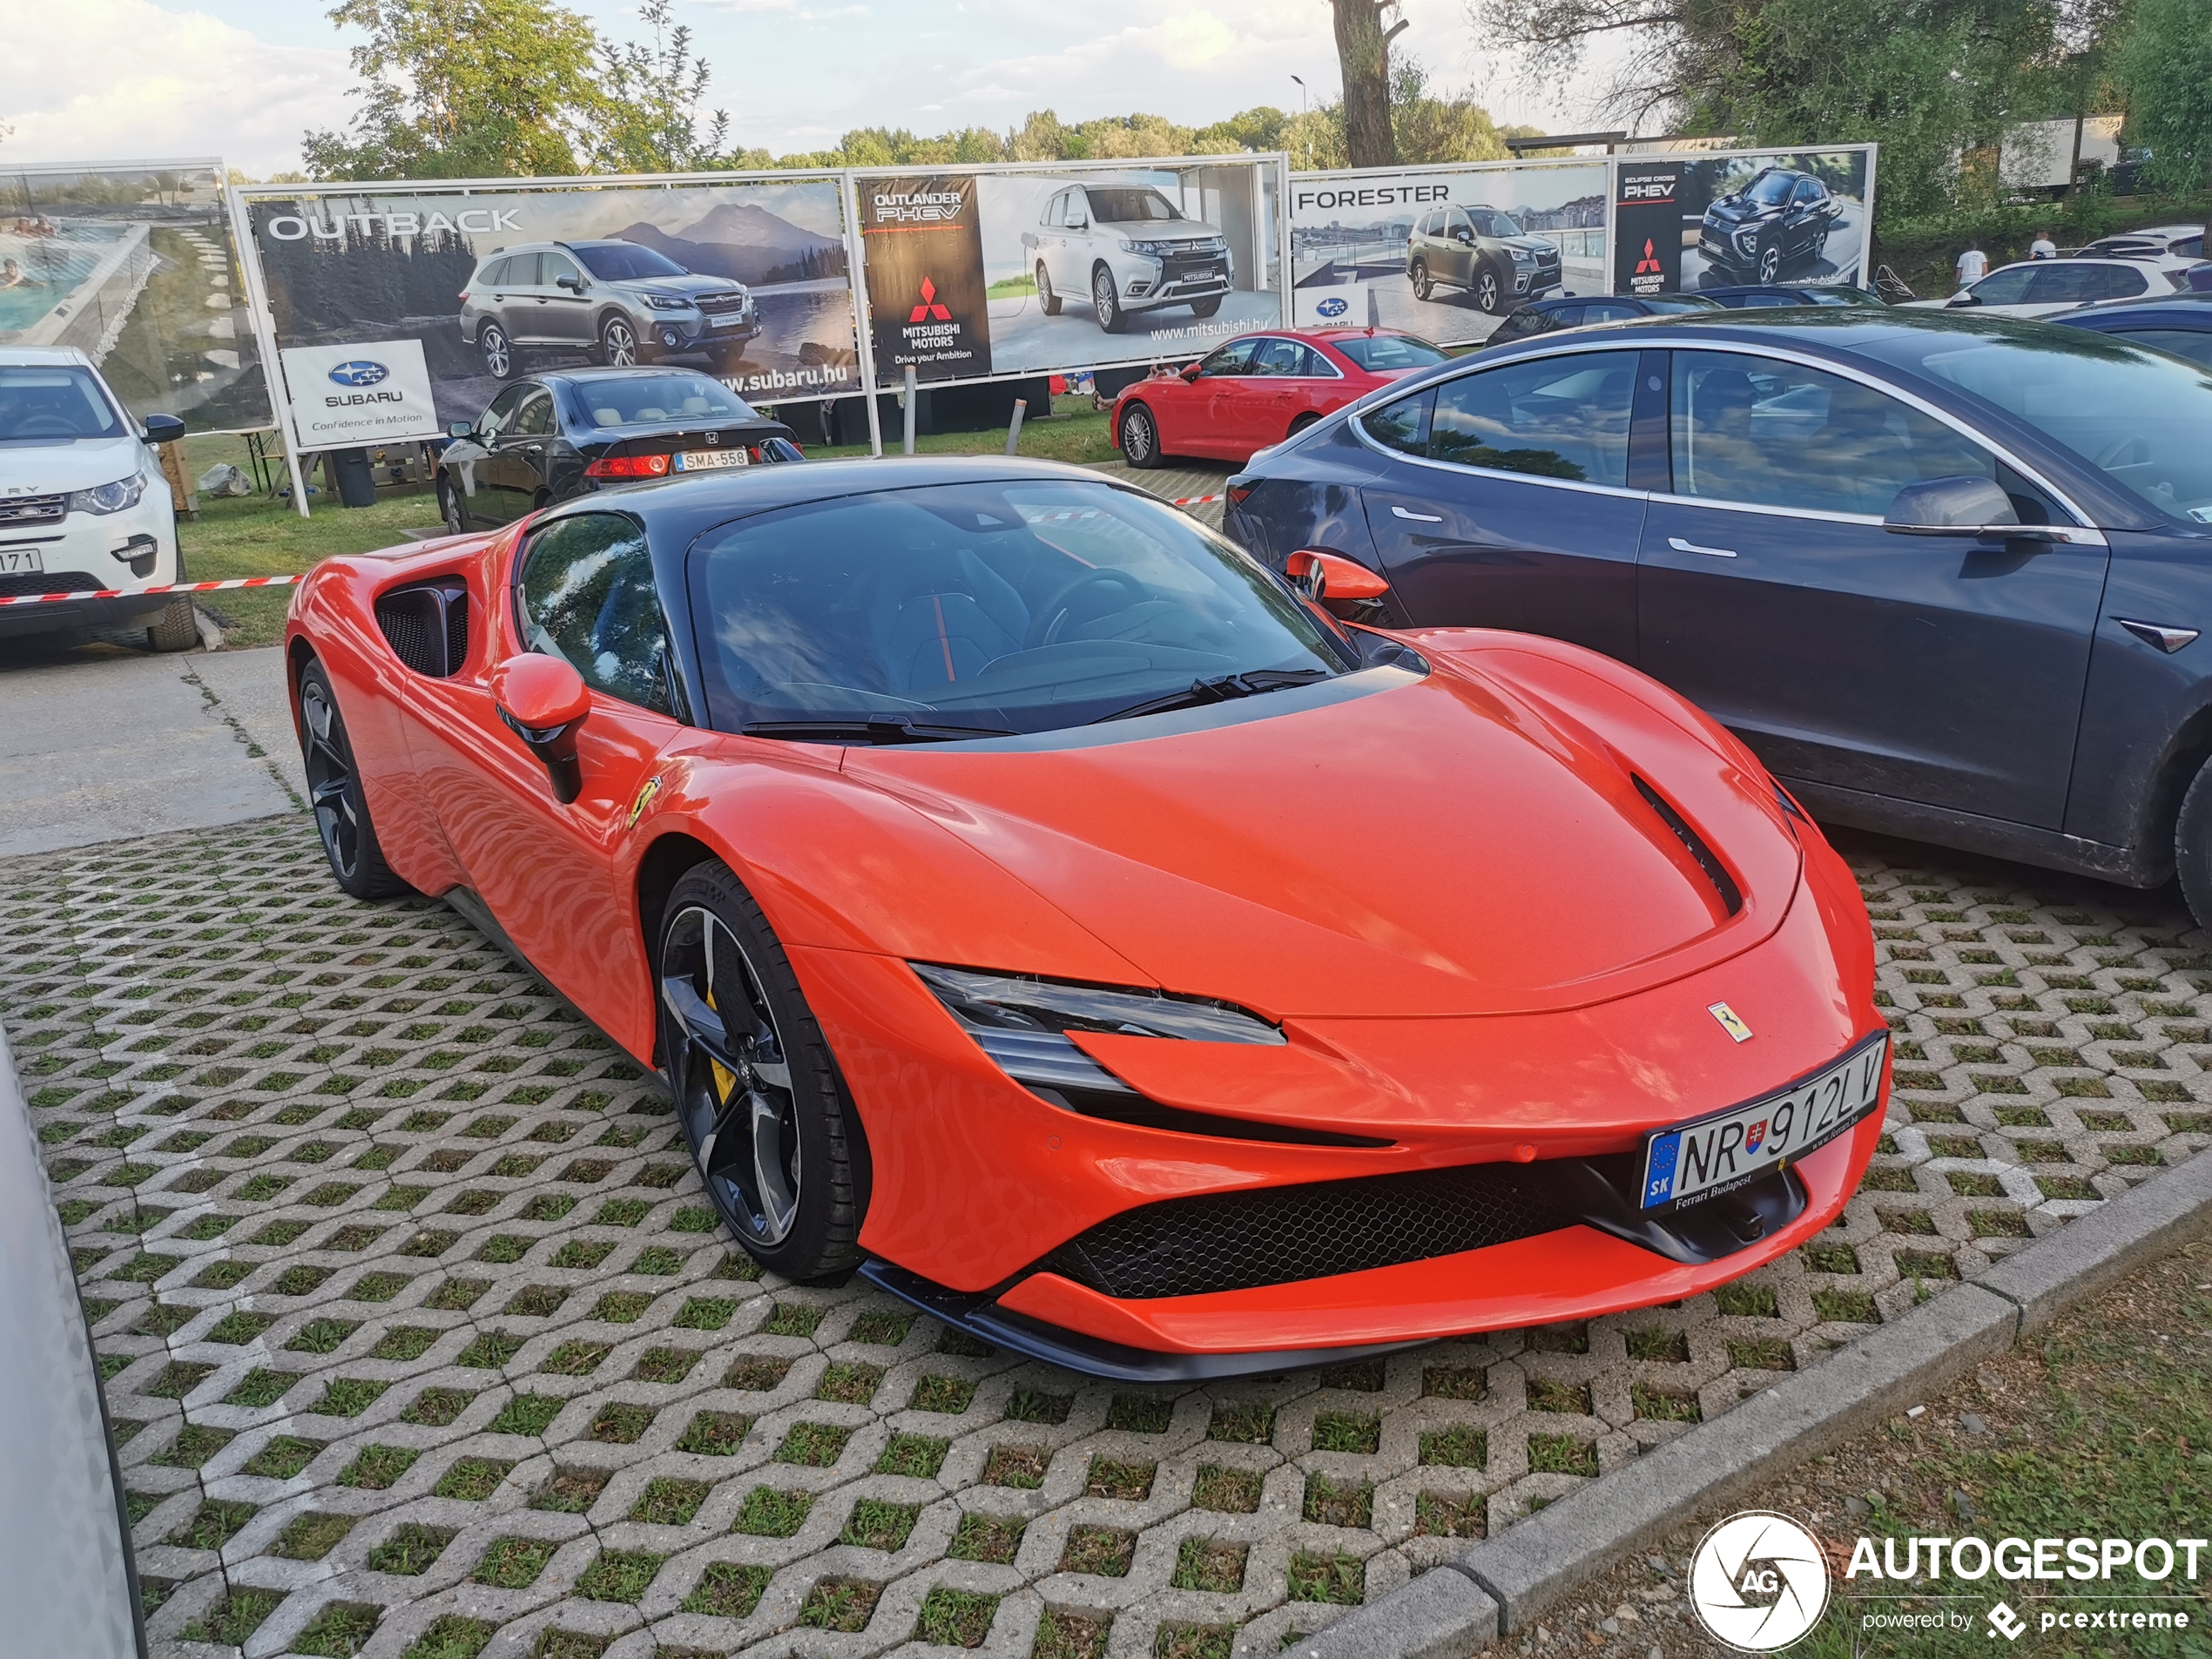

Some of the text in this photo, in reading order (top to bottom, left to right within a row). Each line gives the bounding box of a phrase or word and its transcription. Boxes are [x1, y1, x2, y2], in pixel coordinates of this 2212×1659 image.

[2054, 118, 2114, 127] FORSTER
[874, 192, 961, 206] OUTLANDER
[1298, 185, 1449, 210] FORESTER
[1624, 184, 1676, 199] PHEV
[876, 205, 962, 222] PHEV
[268, 208, 523, 240] OUTBACK
[1184, 272, 1213, 282] MITSUBISHI
[1630, 274, 1665, 286] MITSUBISHI
[1635, 284, 1660, 293] MOTORS
[902, 323, 961, 339] MITSUBISHI
[1150, 318, 1268, 341] www.mitsubishi.hu
[911, 336, 954, 349] MOTORS
[894, 349, 973, 364] Drive your Ambition
[719, 363, 848, 393] w.subaru.hu
[325, 391, 403, 408] SUBARU
[312, 414, 422, 431] Confidence in Motion
[686, 451, 745, 469] SMA-558
[0, 486, 39, 496] RY
[1679, 1043, 1882, 1192] NR 912LV
[1650, 1177, 1670, 1197] SK
[1675, 1175, 1752, 1211] Ferrari Budapest
